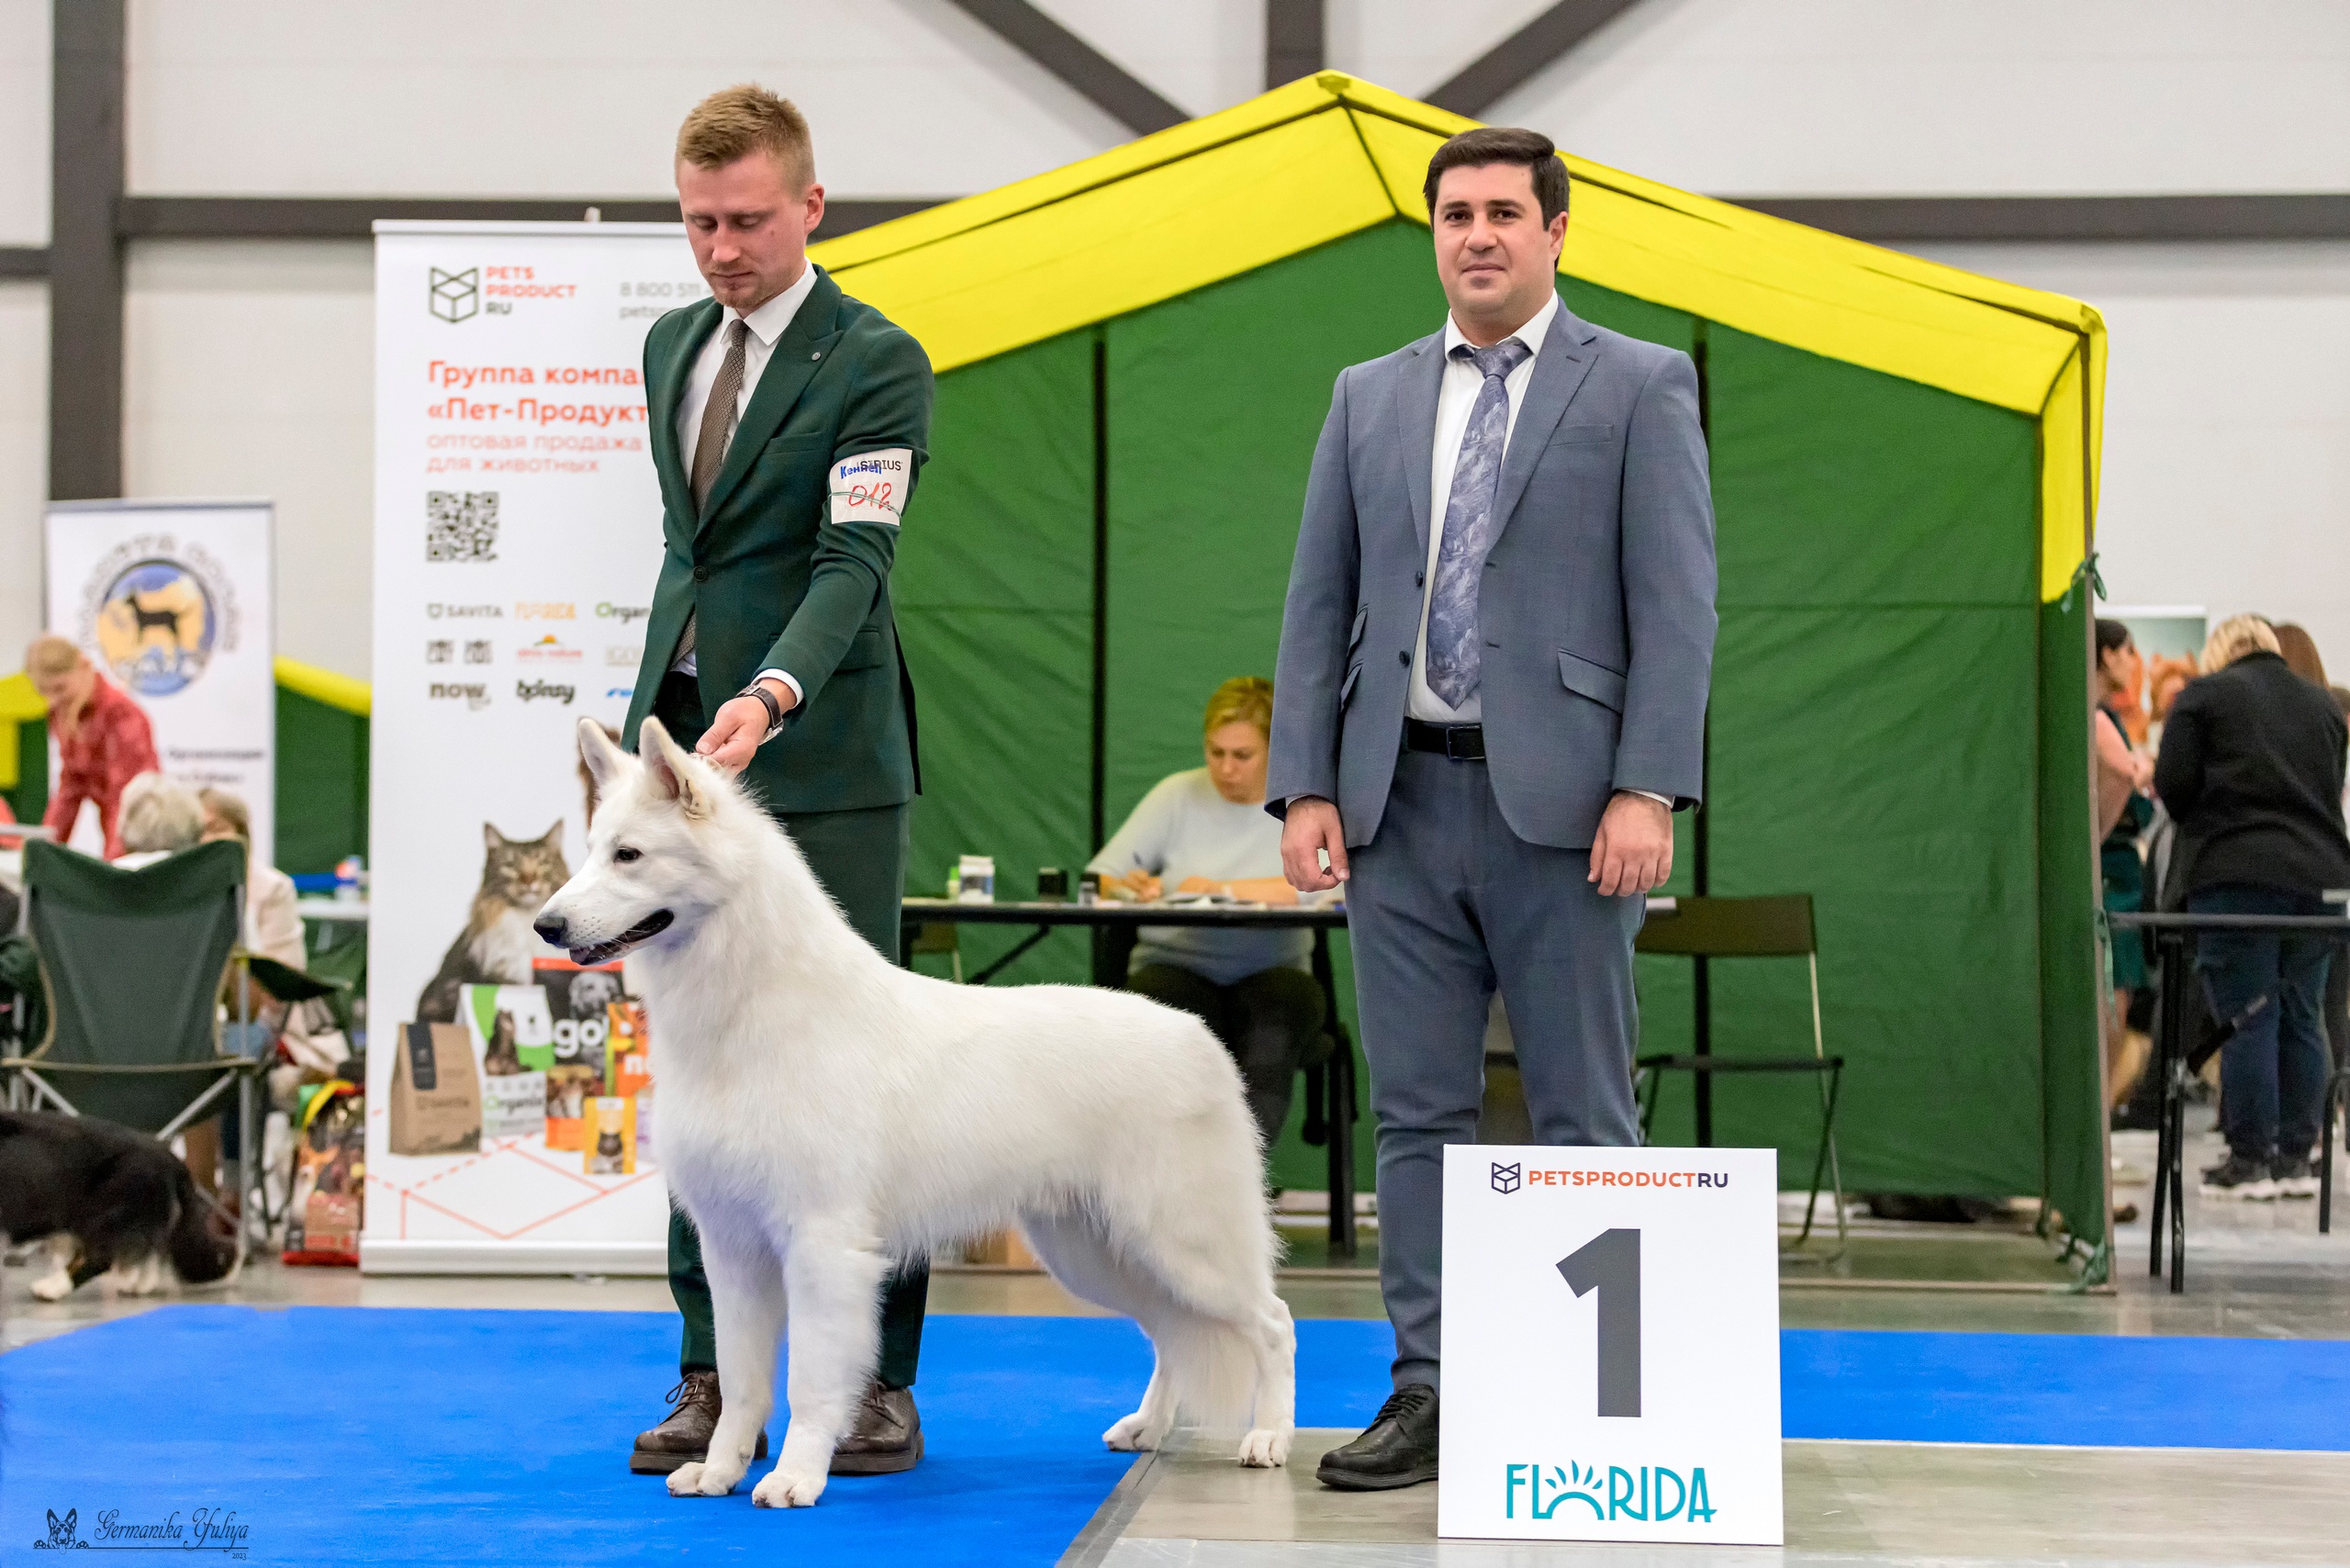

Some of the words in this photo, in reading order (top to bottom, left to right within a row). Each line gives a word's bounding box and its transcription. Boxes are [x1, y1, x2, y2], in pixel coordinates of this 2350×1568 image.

[486, 265, 535, 280] PETS
[486, 284, 577, 299] PRODUCT
[635, 281, 673, 297] 800
[486, 302, 513, 316] RU
[429, 360, 535, 389] Группа
[427, 434, 528, 451] оптовая
[533, 434, 643, 453] продажа
[426, 456, 472, 474] для
[479, 457, 600, 474] животных
[430, 682, 487, 699] now
[1528, 1170, 1729, 1189] PETSPRODUCTRU
[1555, 1227, 1642, 1418] 1
[1505, 1459, 1718, 1524] FLORIDA
